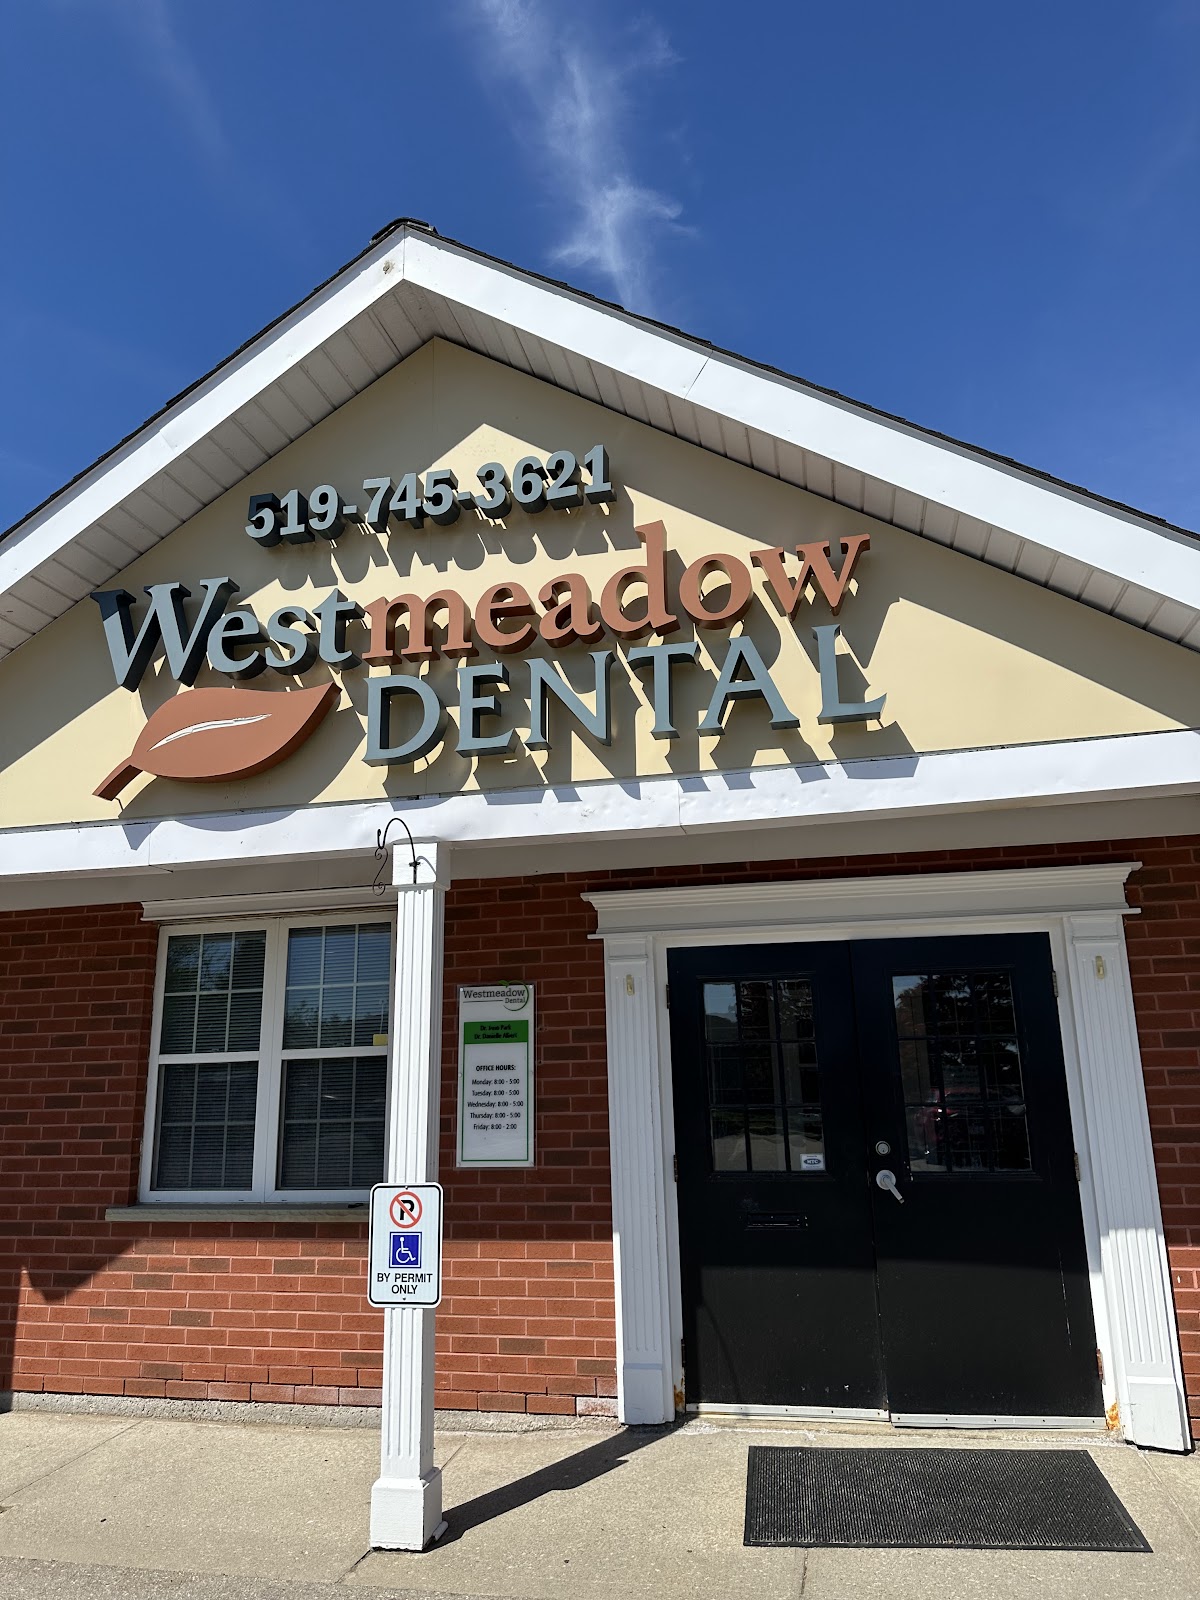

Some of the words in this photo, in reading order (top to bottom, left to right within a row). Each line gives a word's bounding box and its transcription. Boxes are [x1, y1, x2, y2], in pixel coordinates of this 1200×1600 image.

[245, 444, 615, 547] 519-745-3621
[90, 519, 870, 692] Westmeadow
[363, 624, 887, 767] DENTAL
[463, 988, 526, 998] Westmeadow
[377, 1272, 391, 1283] BY
[394, 1273, 433, 1283] PERMIT
[391, 1284, 418, 1294] ONLY
